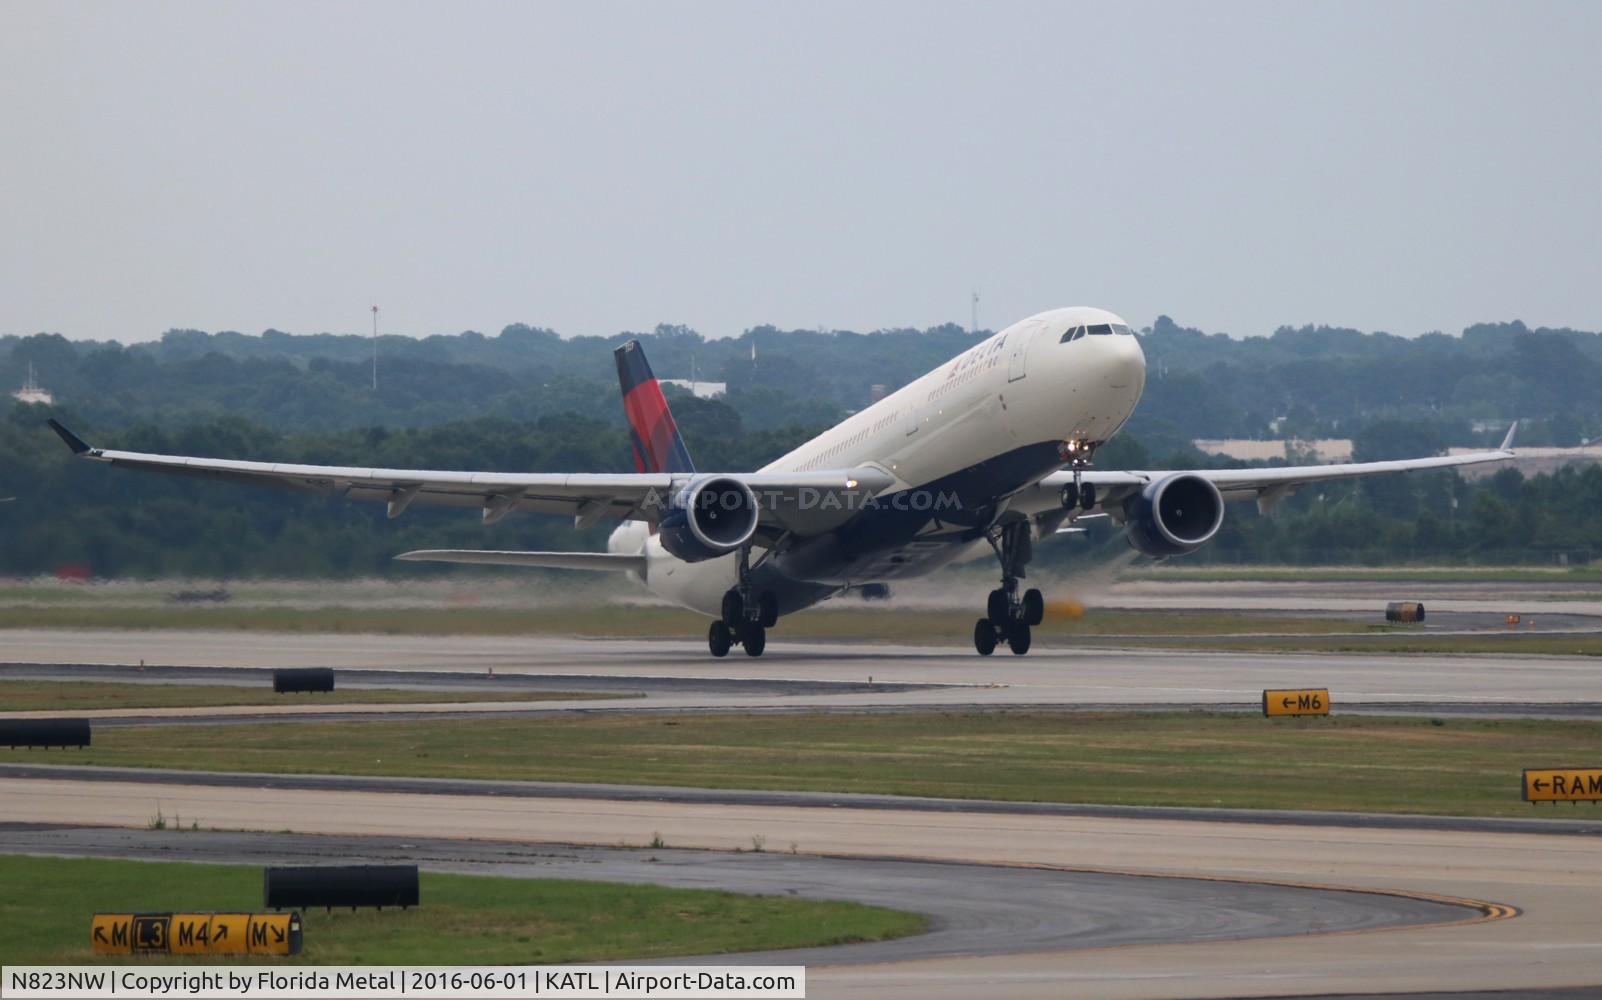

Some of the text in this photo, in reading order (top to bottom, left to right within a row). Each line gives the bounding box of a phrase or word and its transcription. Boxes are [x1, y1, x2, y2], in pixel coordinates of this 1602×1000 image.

[1298, 694, 1322, 710] M6
[112, 921, 267, 947] M L3 M4 M
